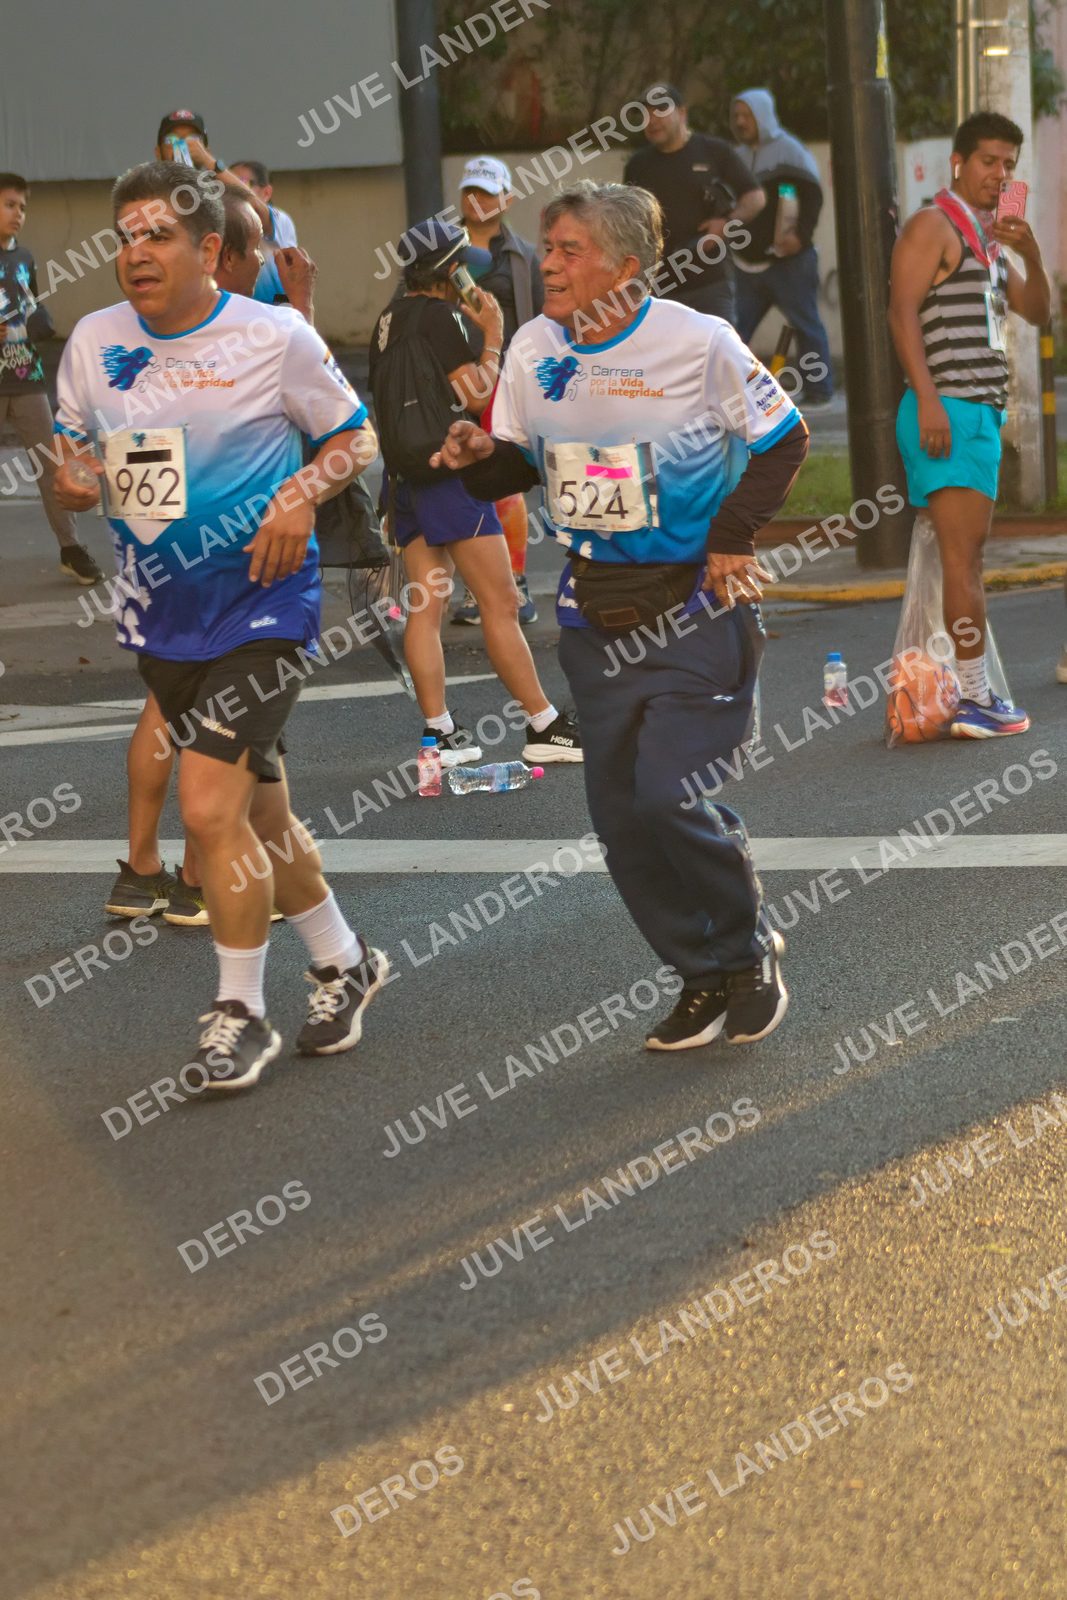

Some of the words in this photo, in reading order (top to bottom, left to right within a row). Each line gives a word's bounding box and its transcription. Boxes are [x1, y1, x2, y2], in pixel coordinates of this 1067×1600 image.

[591, 365, 644, 378] Carrera
[620, 378, 644, 388] Vida
[558, 480, 629, 519] 524
[550, 734, 574, 748] HOKA
